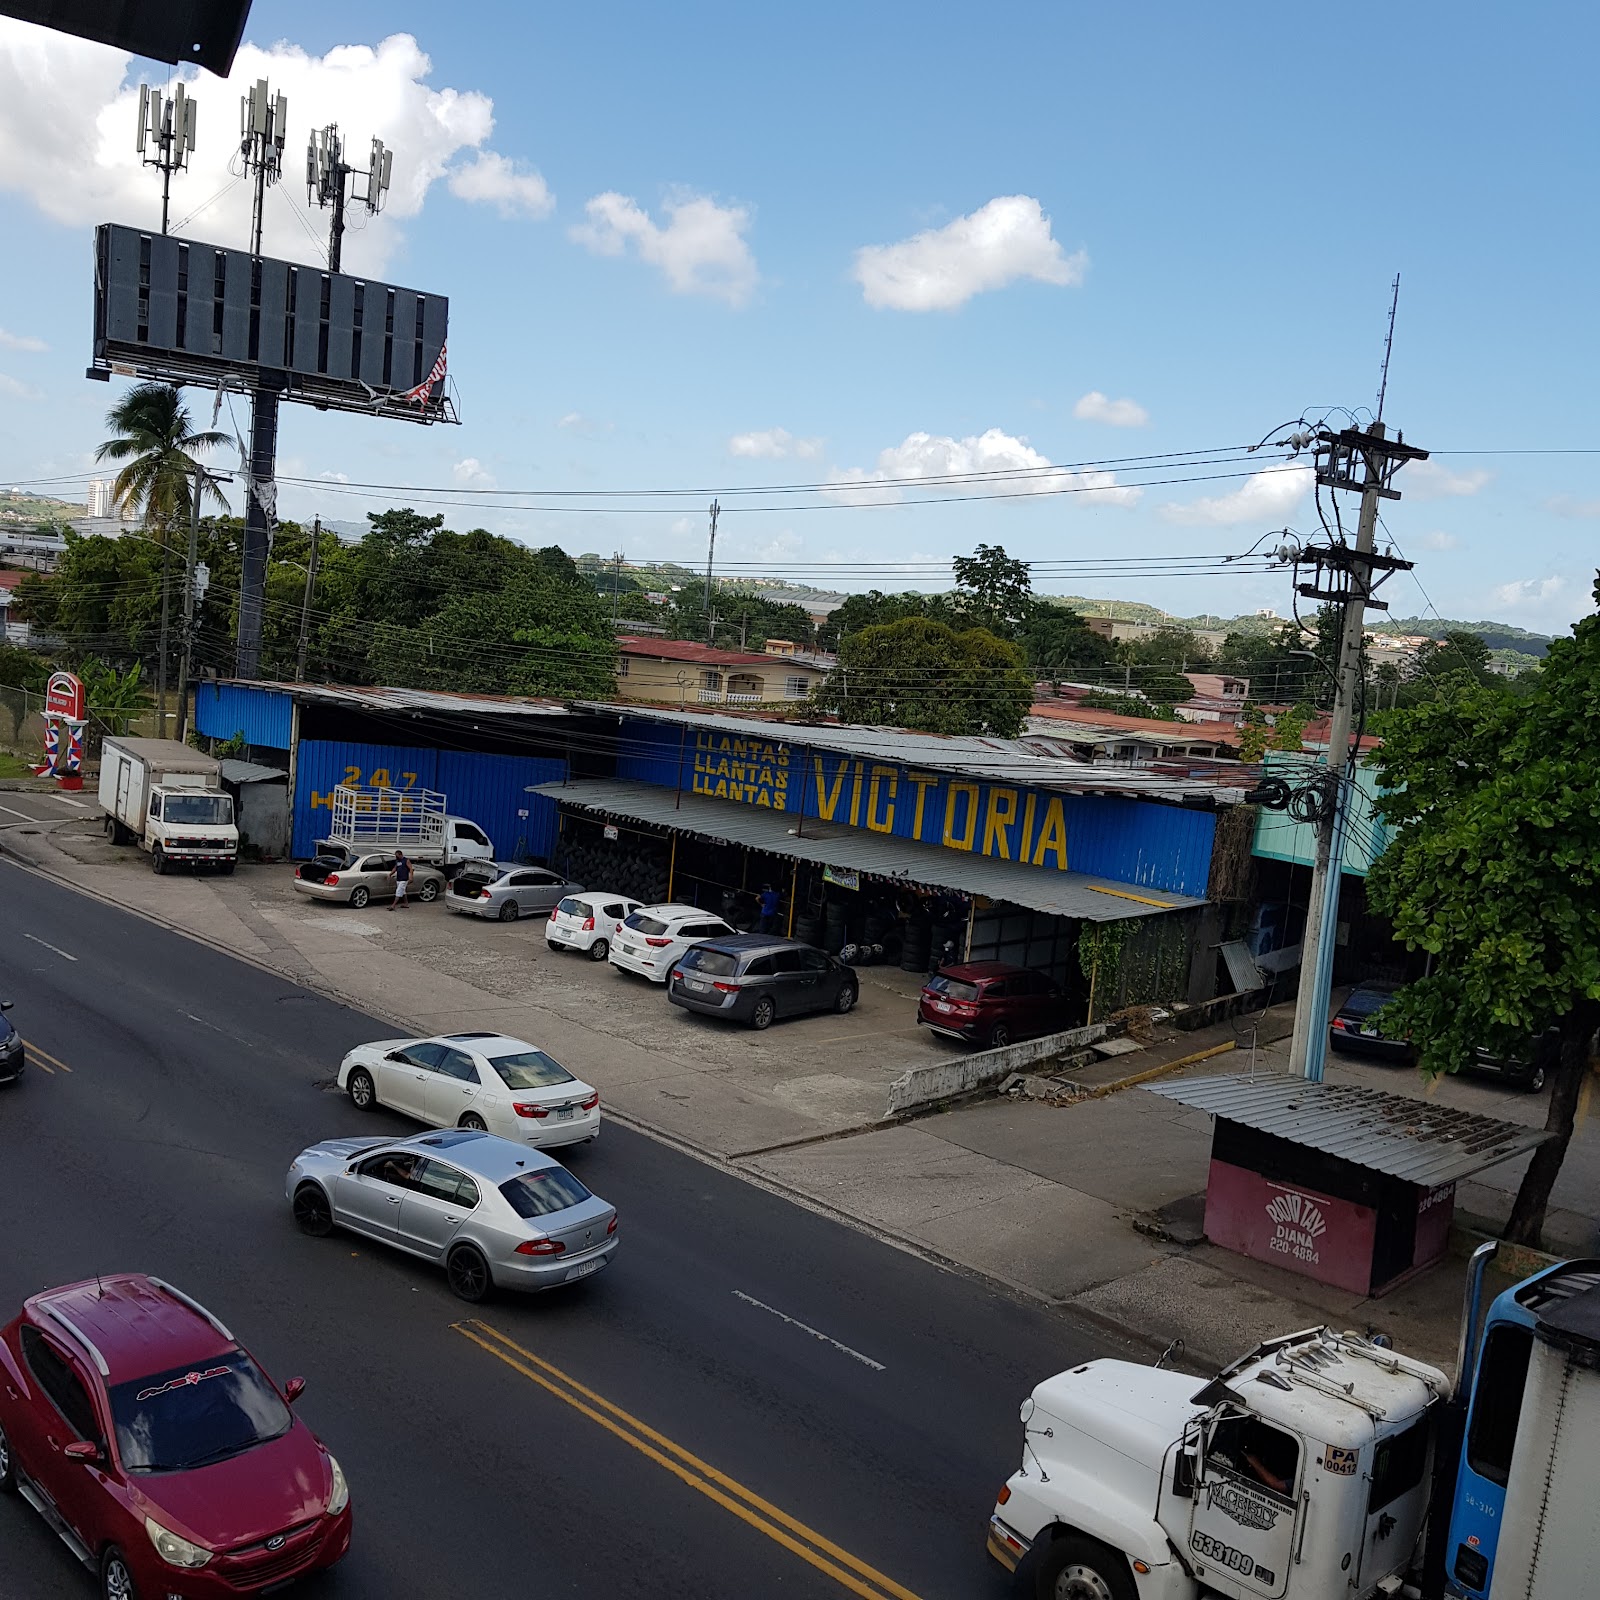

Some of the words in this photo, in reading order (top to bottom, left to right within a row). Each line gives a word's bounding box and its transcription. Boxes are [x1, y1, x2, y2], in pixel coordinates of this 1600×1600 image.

[696, 732, 791, 766] LLANTAS
[694, 753, 789, 789] LLANTAS
[692, 773, 787, 811] LLANTAS
[813, 753, 1068, 871] VICTORIA
[1265, 1194, 1302, 1224] RADIO
[1300, 1199, 1327, 1238] TAXI
[1276, 1225, 1314, 1250] DIANA
[1332, 1448, 1356, 1462] PA
[1191, 1529, 1255, 1577] 533199
